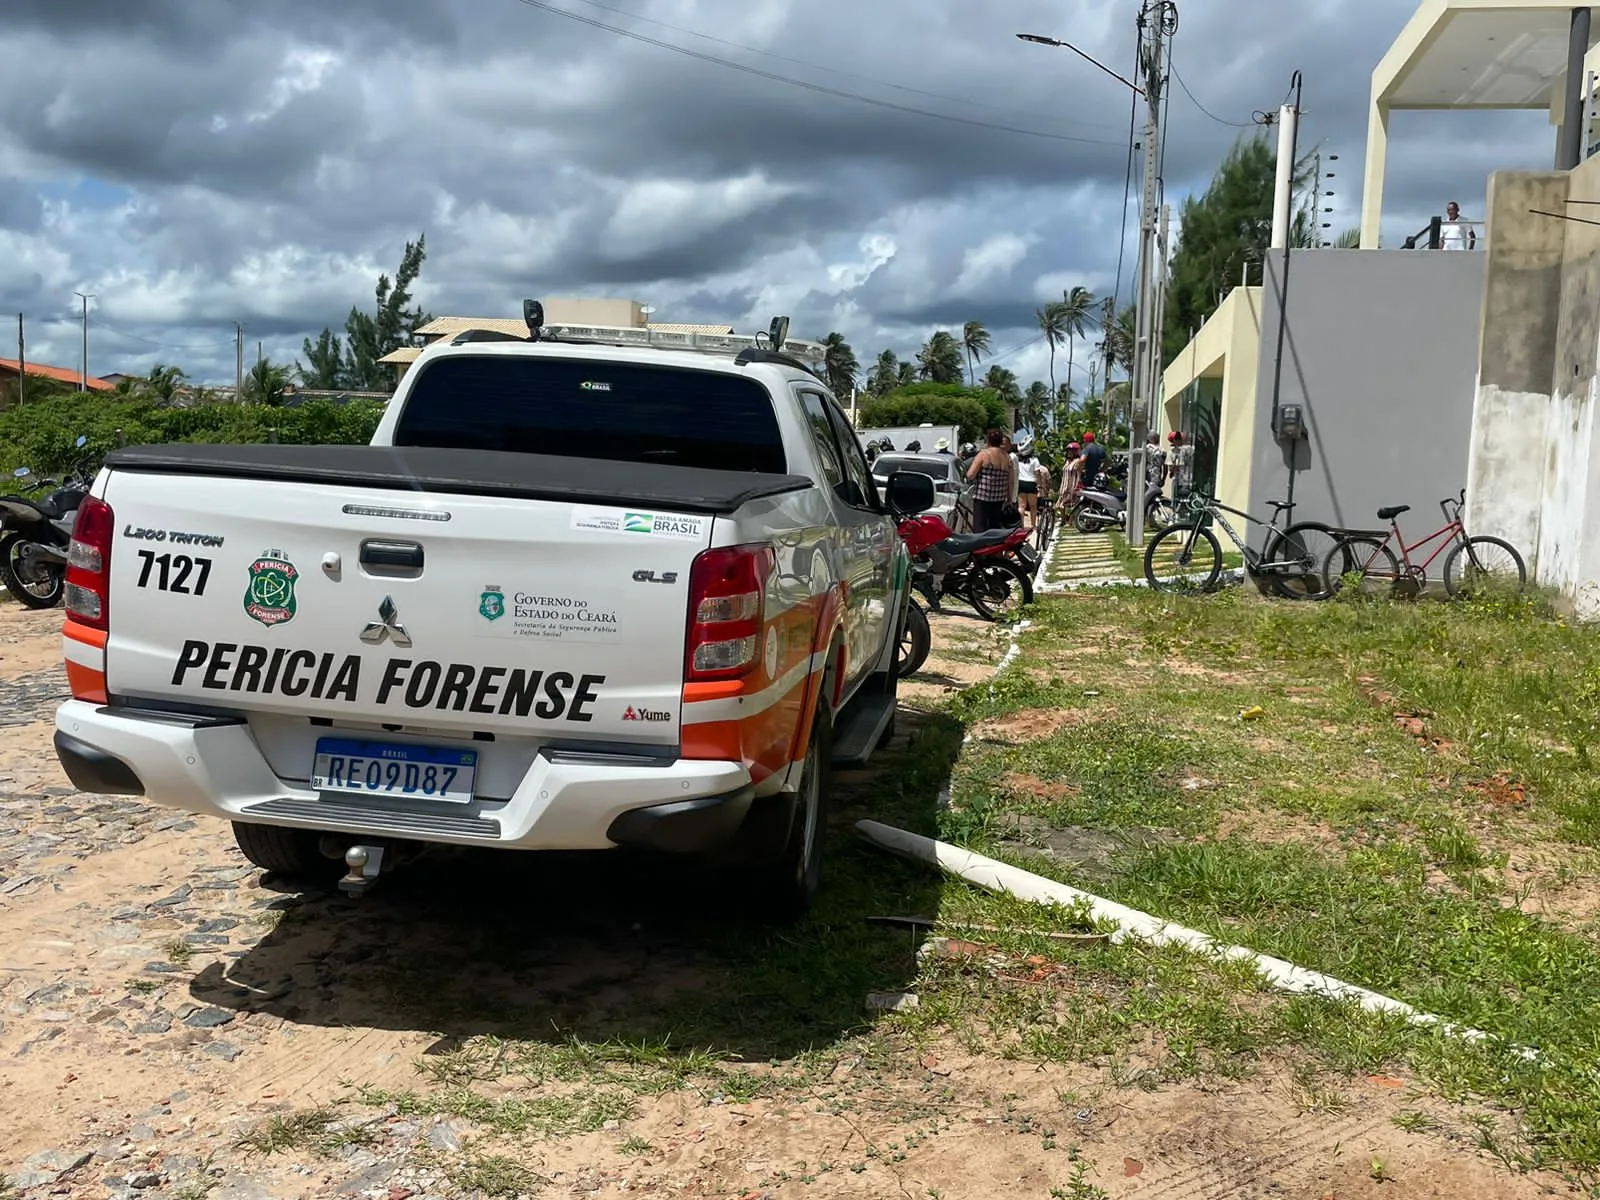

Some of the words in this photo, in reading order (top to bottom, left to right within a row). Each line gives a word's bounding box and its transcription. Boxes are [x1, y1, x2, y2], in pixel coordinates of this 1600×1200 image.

[123, 524, 167, 541] L200
[169, 531, 225, 548] TRITON
[653, 520, 700, 534] BRASIL
[137, 549, 212, 597] 7127
[632, 569, 678, 584] GLS
[171, 639, 361, 702] PERÍCIA
[375, 658, 606, 722] FORENSE
[638, 708, 671, 722] Yume
